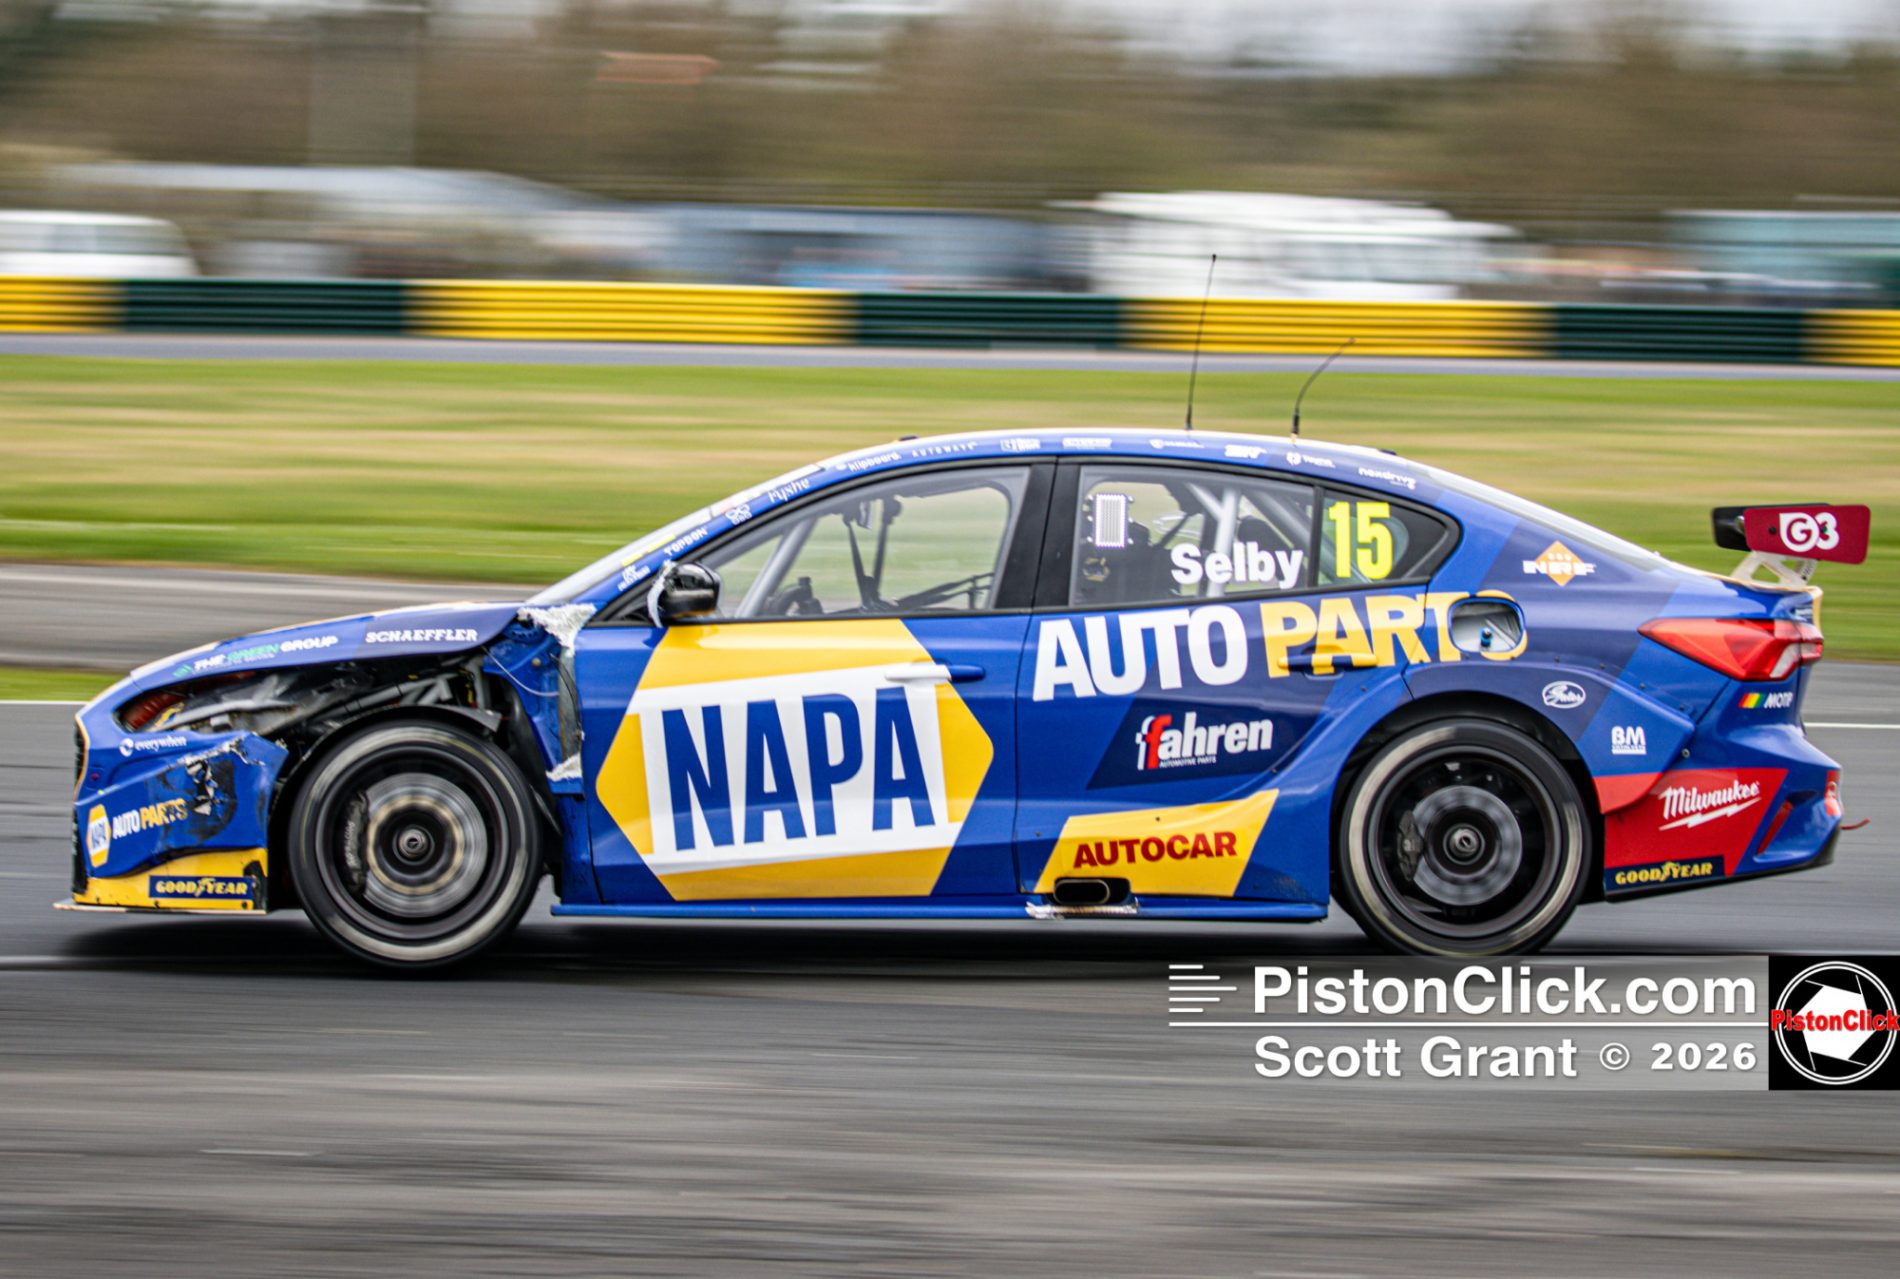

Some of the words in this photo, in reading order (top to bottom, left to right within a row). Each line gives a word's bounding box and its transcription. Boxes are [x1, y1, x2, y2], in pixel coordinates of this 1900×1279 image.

[663, 527, 709, 557] TOPDON
[1329, 501, 1393, 580] 15
[1779, 512, 1840, 552] G3
[1170, 541, 1304, 590] Selby
[1523, 560, 1597, 576] NRF
[194, 653, 225, 671] THE
[281, 635, 339, 653] GROUP
[365, 628, 478, 644] SCHAEFFLER
[1032, 605, 1249, 702] AUTO
[1135, 711, 1274, 771] fahren
[1611, 726, 1646, 746] BM
[661, 686, 936, 851] NAPA
[112, 809, 141, 840] AUTO
[140, 798, 189, 830] PARTS
[1658, 780, 1761, 820] Milwaukee
[1073, 831, 1238, 869] AUTOCAR
[155, 877, 249, 898] GOODYEAR
[1615, 861, 1714, 885] GOODYEAR
